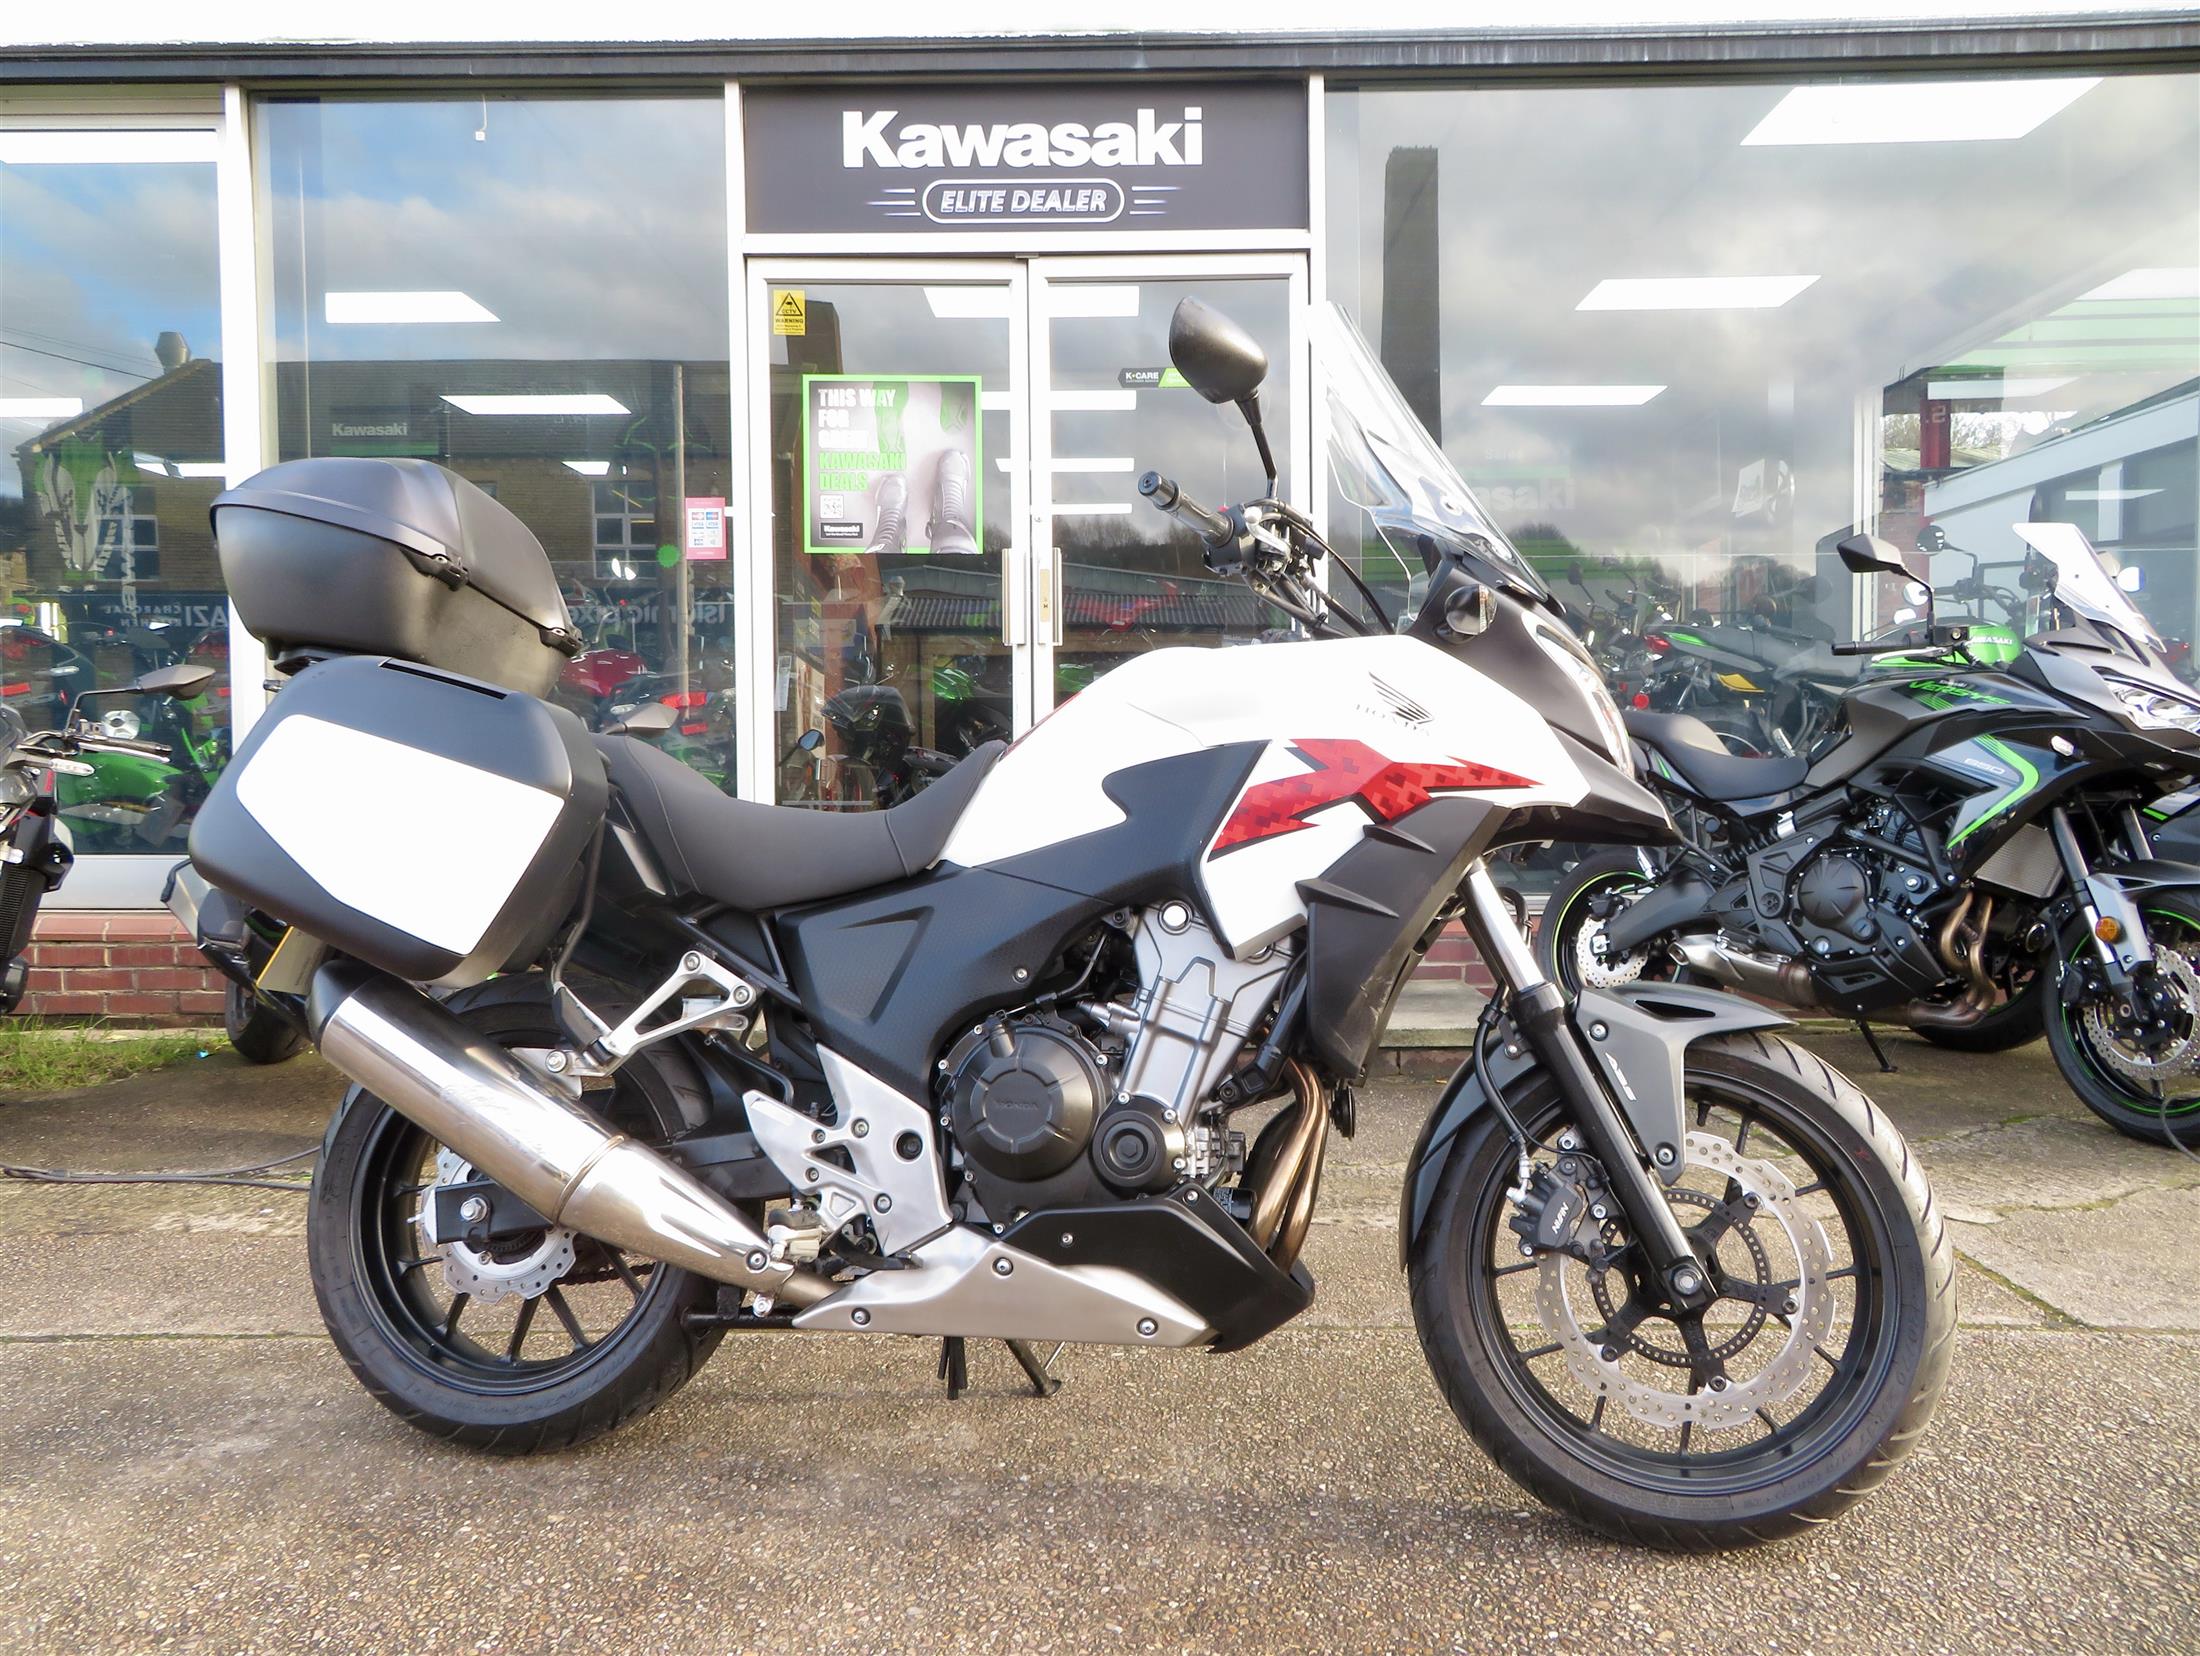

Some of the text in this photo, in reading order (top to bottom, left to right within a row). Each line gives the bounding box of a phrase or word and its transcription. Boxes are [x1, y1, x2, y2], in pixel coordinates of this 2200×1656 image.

[842, 107, 1202, 168] Kawasaki
[940, 189, 1107, 213] ELITE DEALER
[818, 389, 896, 407] THIS WAY
[818, 410, 849, 428] FOR
[332, 423, 408, 436] Kawasaki
[819, 452, 907, 470] KAWASAKI
[819, 472, 869, 491] DEALS
